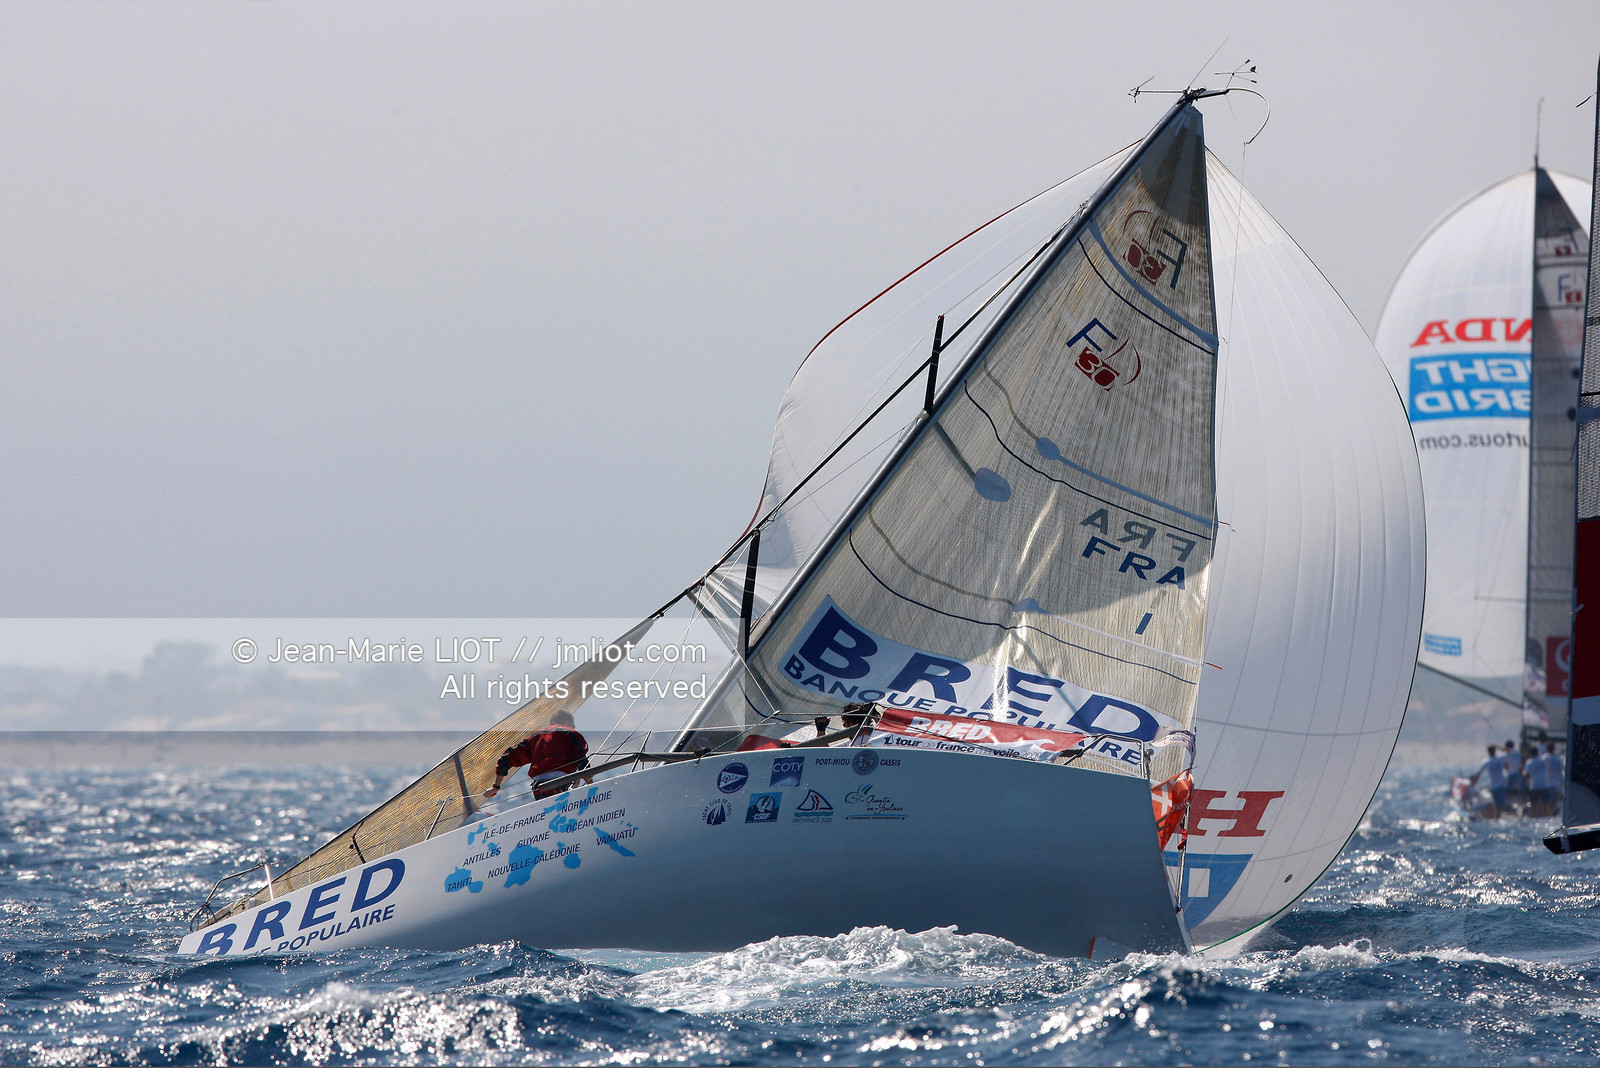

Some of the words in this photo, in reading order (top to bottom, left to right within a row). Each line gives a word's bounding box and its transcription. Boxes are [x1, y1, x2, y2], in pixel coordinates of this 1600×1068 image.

[1066, 318, 1118, 352] F
[1082, 536, 1185, 590] FRA
[798, 606, 1160, 743] BRED
[895, 737, 923, 747] tour
[936, 741, 975, 753] france
[993, 748, 1020, 758] voile
[904, 716, 992, 741] BRED
[773, 761, 803, 773] COTY
[815, 758, 850, 766] PORT-MIOU
[880, 759, 901, 767] CASSIS
[463, 847, 501, 867] ANTILLES
[517, 831, 550, 848] GUYANE
[566, 817, 595, 834] OCÉAN
[597, 808, 626, 824] INDIEN
[484, 812, 546, 840] ILE-DE-FRANCE
[561, 790, 612, 814] NORMANDIE
[447, 876, 473, 892] TAHITI
[488, 843, 580, 879] NOUVELLE-CALÉDONIE
[596, 827, 636, 846] VANUATU
[196, 858, 406, 955] BRED
[277, 904, 395, 951] POPULAIRE
